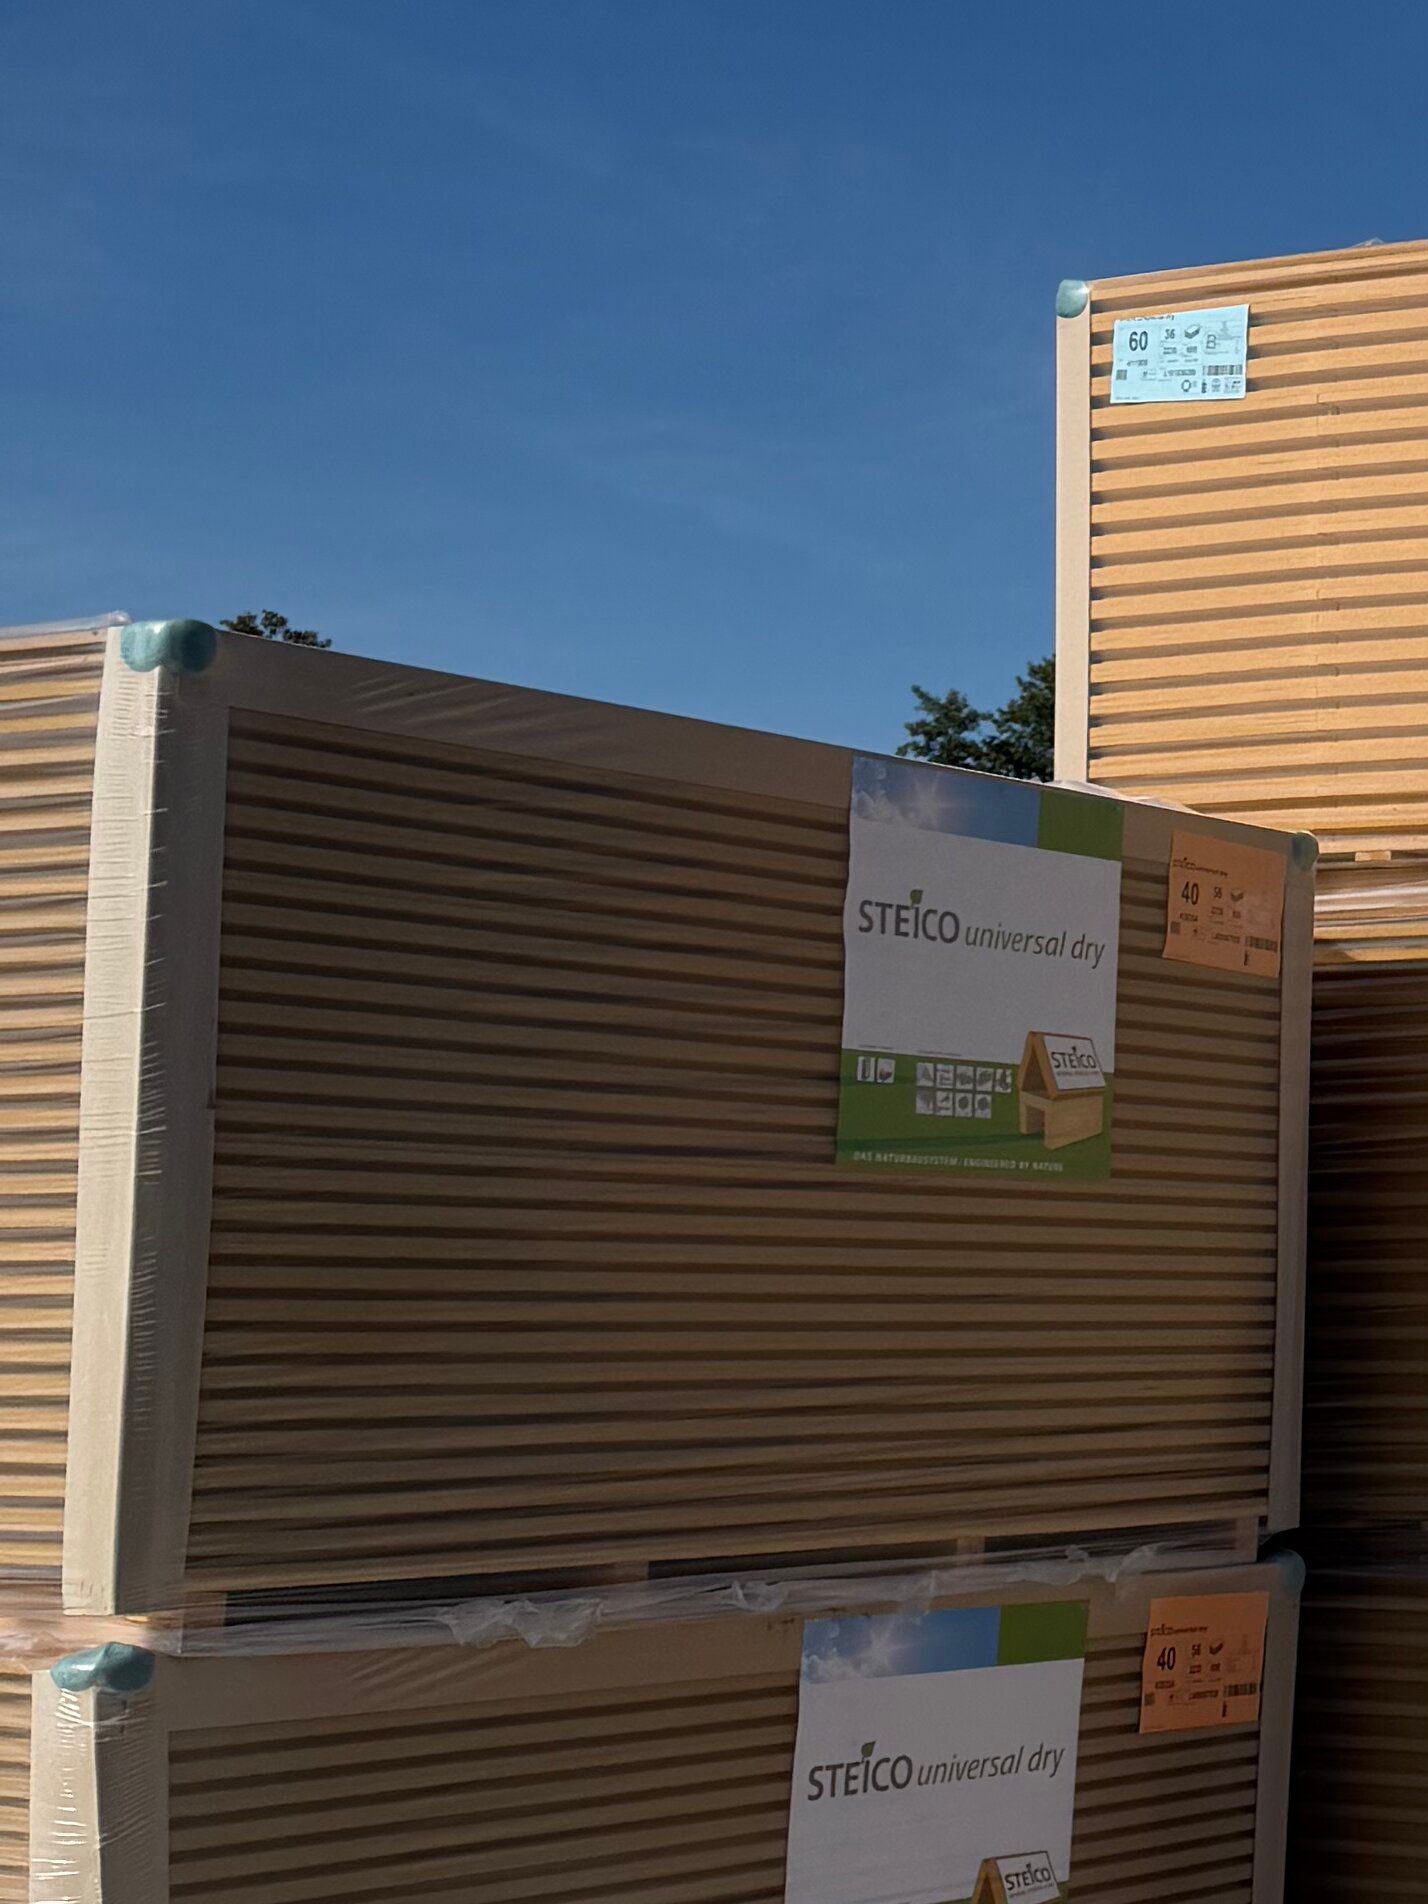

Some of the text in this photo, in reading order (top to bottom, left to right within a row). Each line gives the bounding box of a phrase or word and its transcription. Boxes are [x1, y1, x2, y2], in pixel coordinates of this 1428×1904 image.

[1129, 330, 1149, 352] 60
[1164, 329, 1176, 340] 36
[1181, 881, 1200, 906] 40
[858, 899, 1106, 969] STEICO universal dry
[1051, 1050, 1097, 1069] STEICO
[1157, 1646, 1176, 1670] 40
[808, 1743, 1065, 1801] STEICO universal dry
[1004, 1867, 1051, 1891] STEICO
